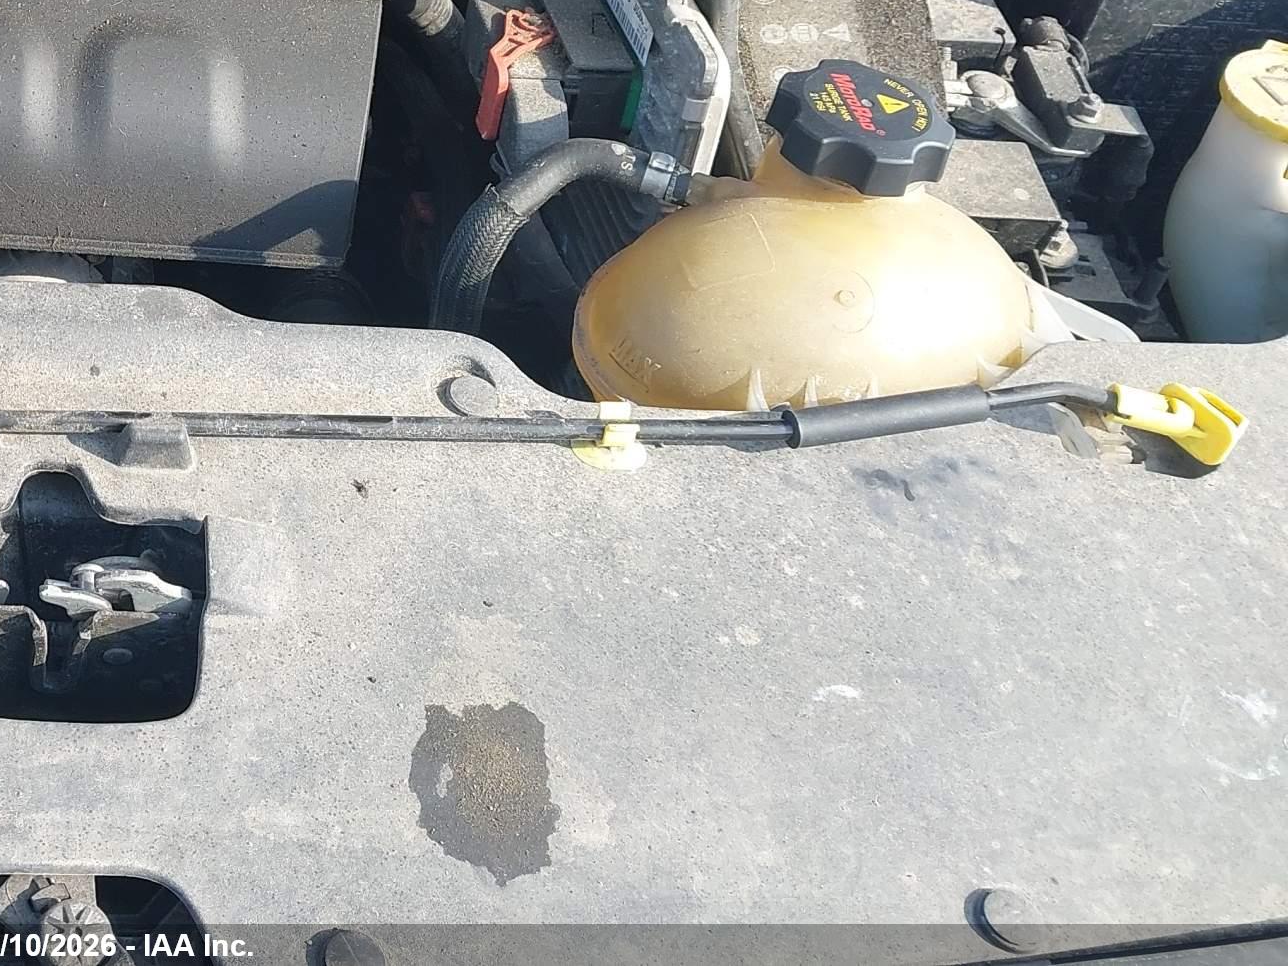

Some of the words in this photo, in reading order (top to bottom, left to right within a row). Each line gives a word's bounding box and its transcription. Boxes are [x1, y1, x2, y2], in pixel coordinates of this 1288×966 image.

[824, 83, 843, 105] SURGE
[838, 103, 854, 122] TANK
[883, 78, 915, 98] NEVER
[911, 99, 929, 118] OPEN
